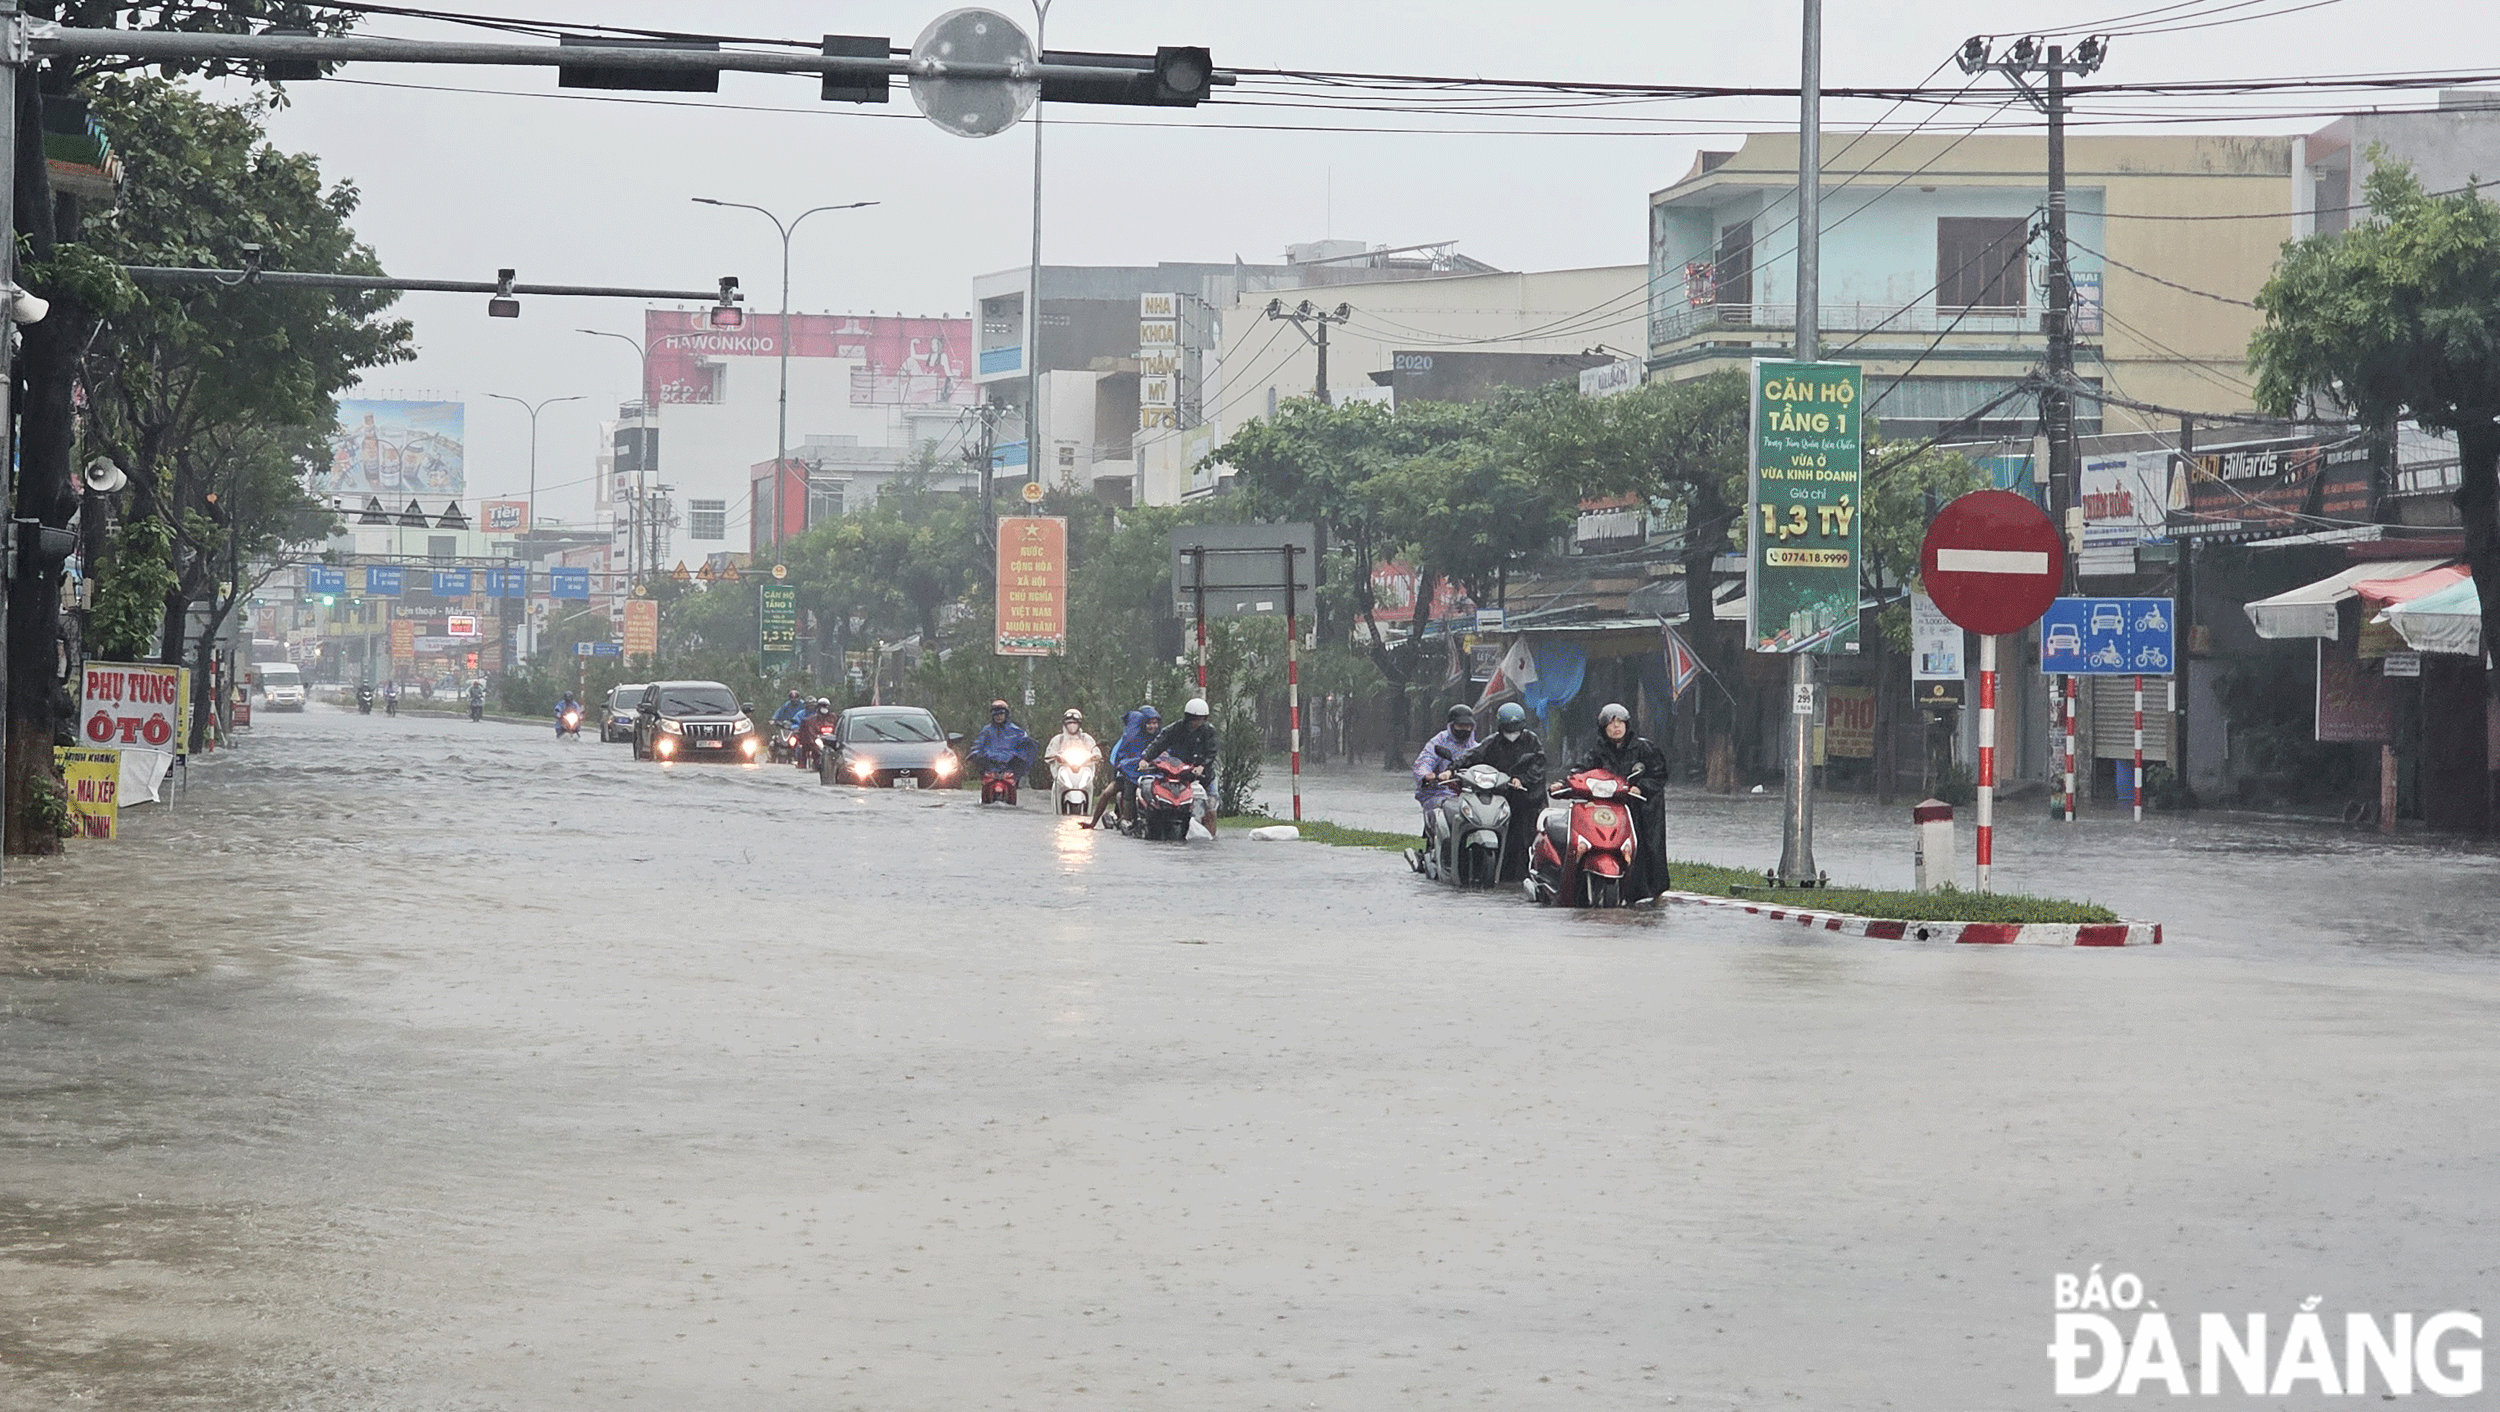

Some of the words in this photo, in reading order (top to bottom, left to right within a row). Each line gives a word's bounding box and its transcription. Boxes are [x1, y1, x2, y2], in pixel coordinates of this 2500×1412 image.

[1145, 296, 1171, 314] NHA
[1141, 324, 1174, 342] KHOA
[666, 334, 774, 351] HAWONKOO
[1395, 354, 1433, 370] 2020
[1148, 379, 1168, 401] MỸ
[1765, 377, 1814, 402] CĂN
[1821, 378, 1855, 409] HỘ
[1769, 402, 1829, 433] TẦNG
[1837, 414, 1846, 434] 1
[1791, 453, 1814, 466] VỪA
[1817, 452, 1827, 467] Ở
[2223, 448, 2278, 481] Billiards
[1760, 465, 1784, 479] VỪA
[1787, 469, 1813, 481] KINH
[1816, 470, 1857, 482] DOANH
[1790, 487, 1808, 499] Giá
[1760, 503, 1809, 540] 1,3
[1818, 493, 1855, 536] TỶ
[1020, 545, 1044, 557] NƯỚC
[1781, 552, 1848, 563] 0774.18.9999
[1010, 560, 1033, 573] CỘNG
[1031, 575, 1047, 588] HỘI
[1011, 605, 1030, 618] VIỆT
[1032, 606, 1052, 617] NAM
[1006, 620, 1030, 632] MUÔN
[86, 670, 124, 709] PHỤ
[1797, 694, 1811, 704] 299
[65, 752, 87, 762] MINH
[88, 752, 115, 764] KHANG
[77, 774, 95, 803] MÁI
[97, 773, 116, 804] XẾP
[82, 810, 111, 840] TRÌNH
